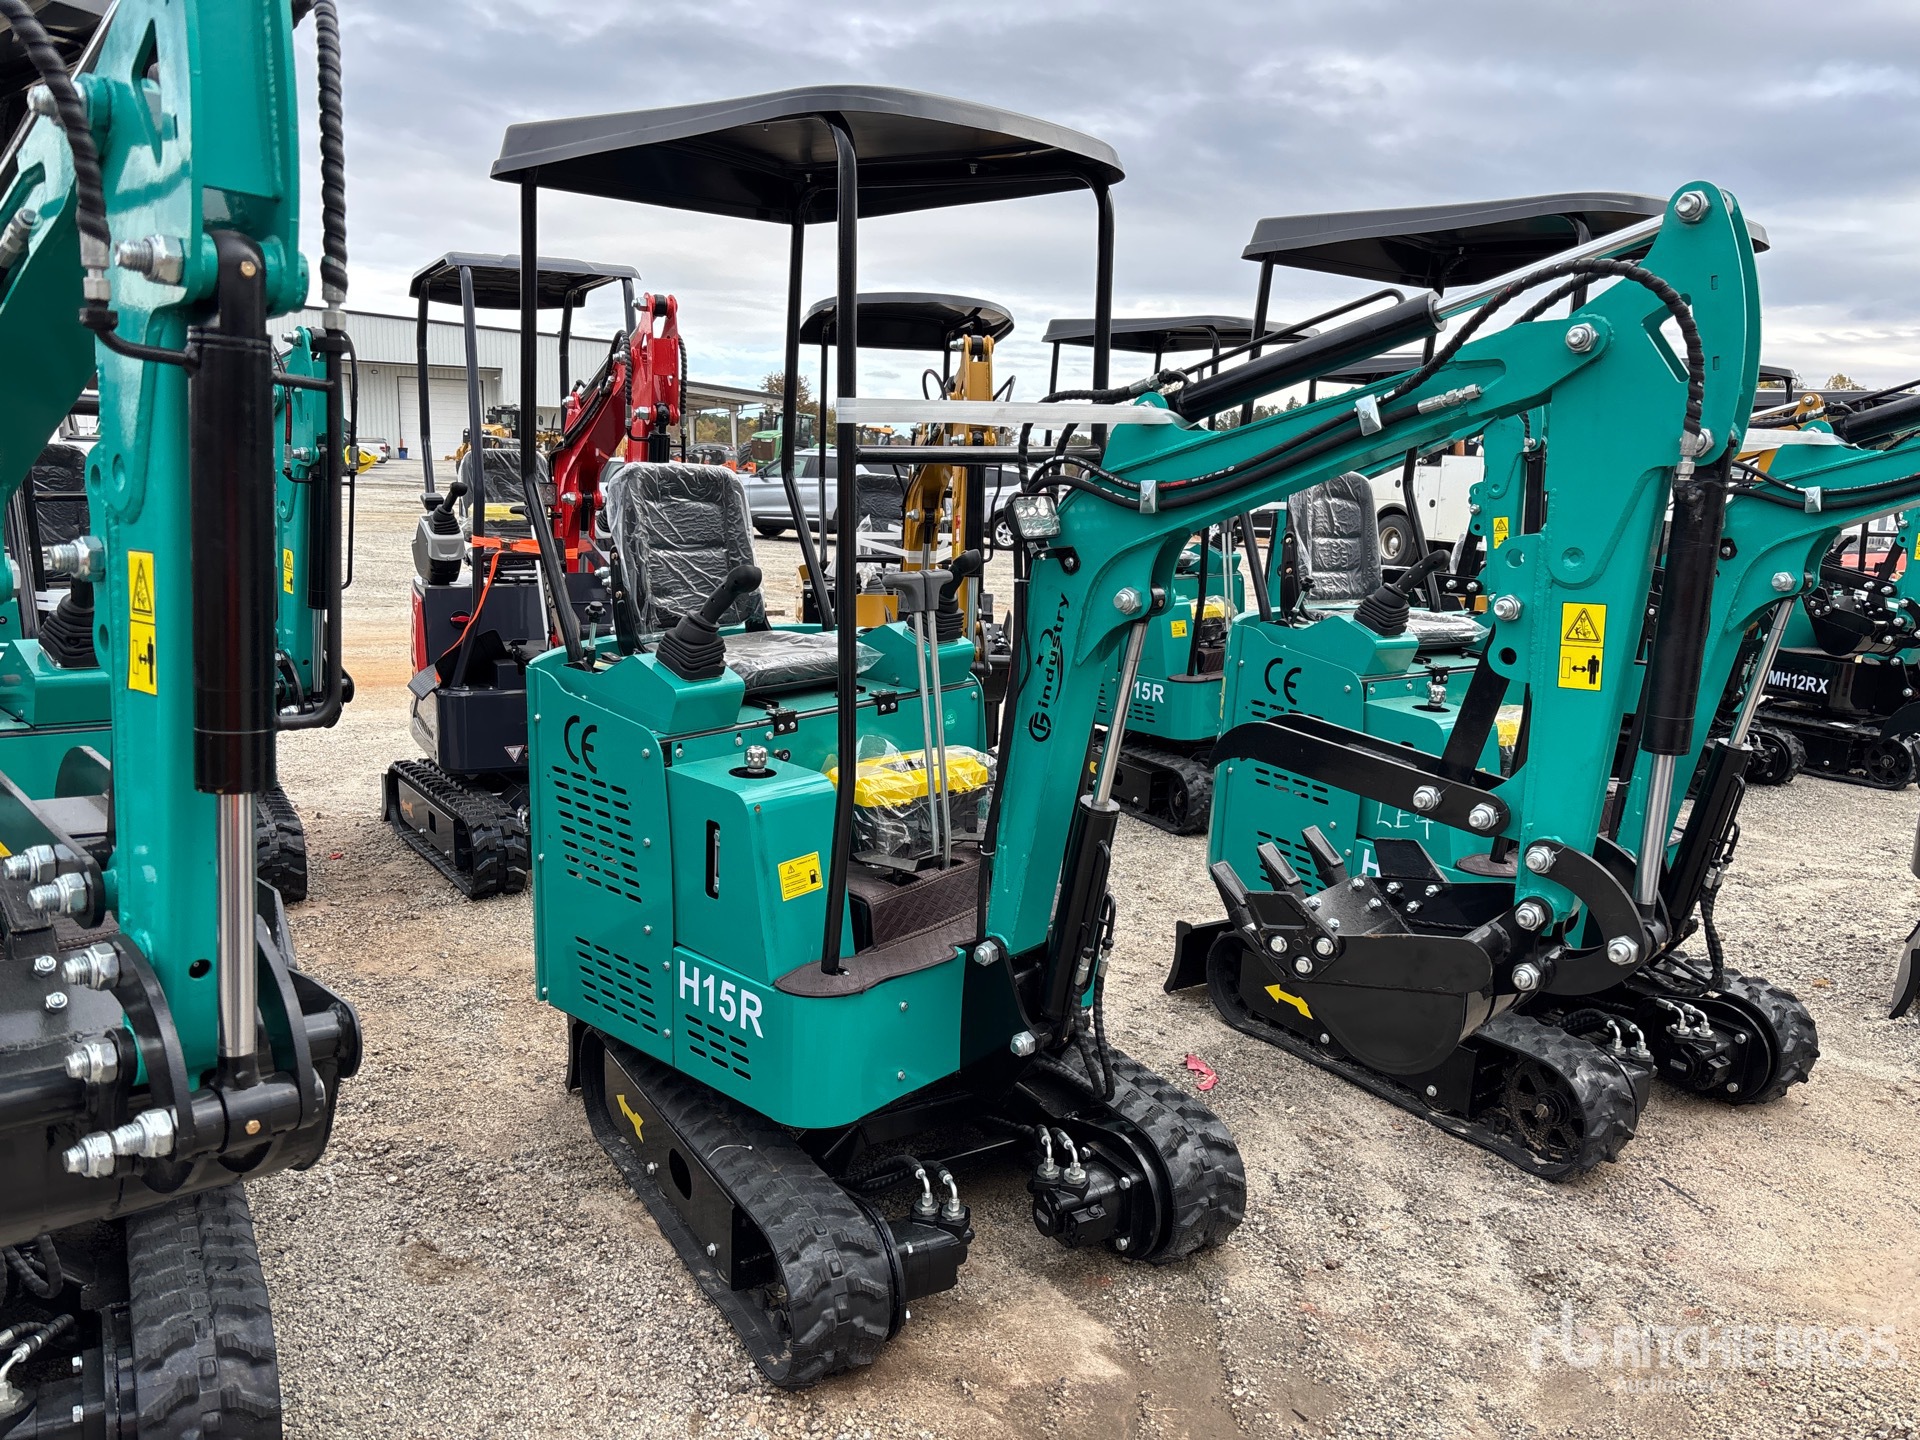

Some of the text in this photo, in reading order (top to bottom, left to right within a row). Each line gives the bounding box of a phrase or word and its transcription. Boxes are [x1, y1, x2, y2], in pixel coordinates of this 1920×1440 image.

[1134, 680, 1165, 704] 15R
[1264, 657, 1302, 706] CE
[1768, 669, 1829, 695] MH12RX
[563, 714, 598, 775] CE
[679, 959, 764, 1039] H15R
